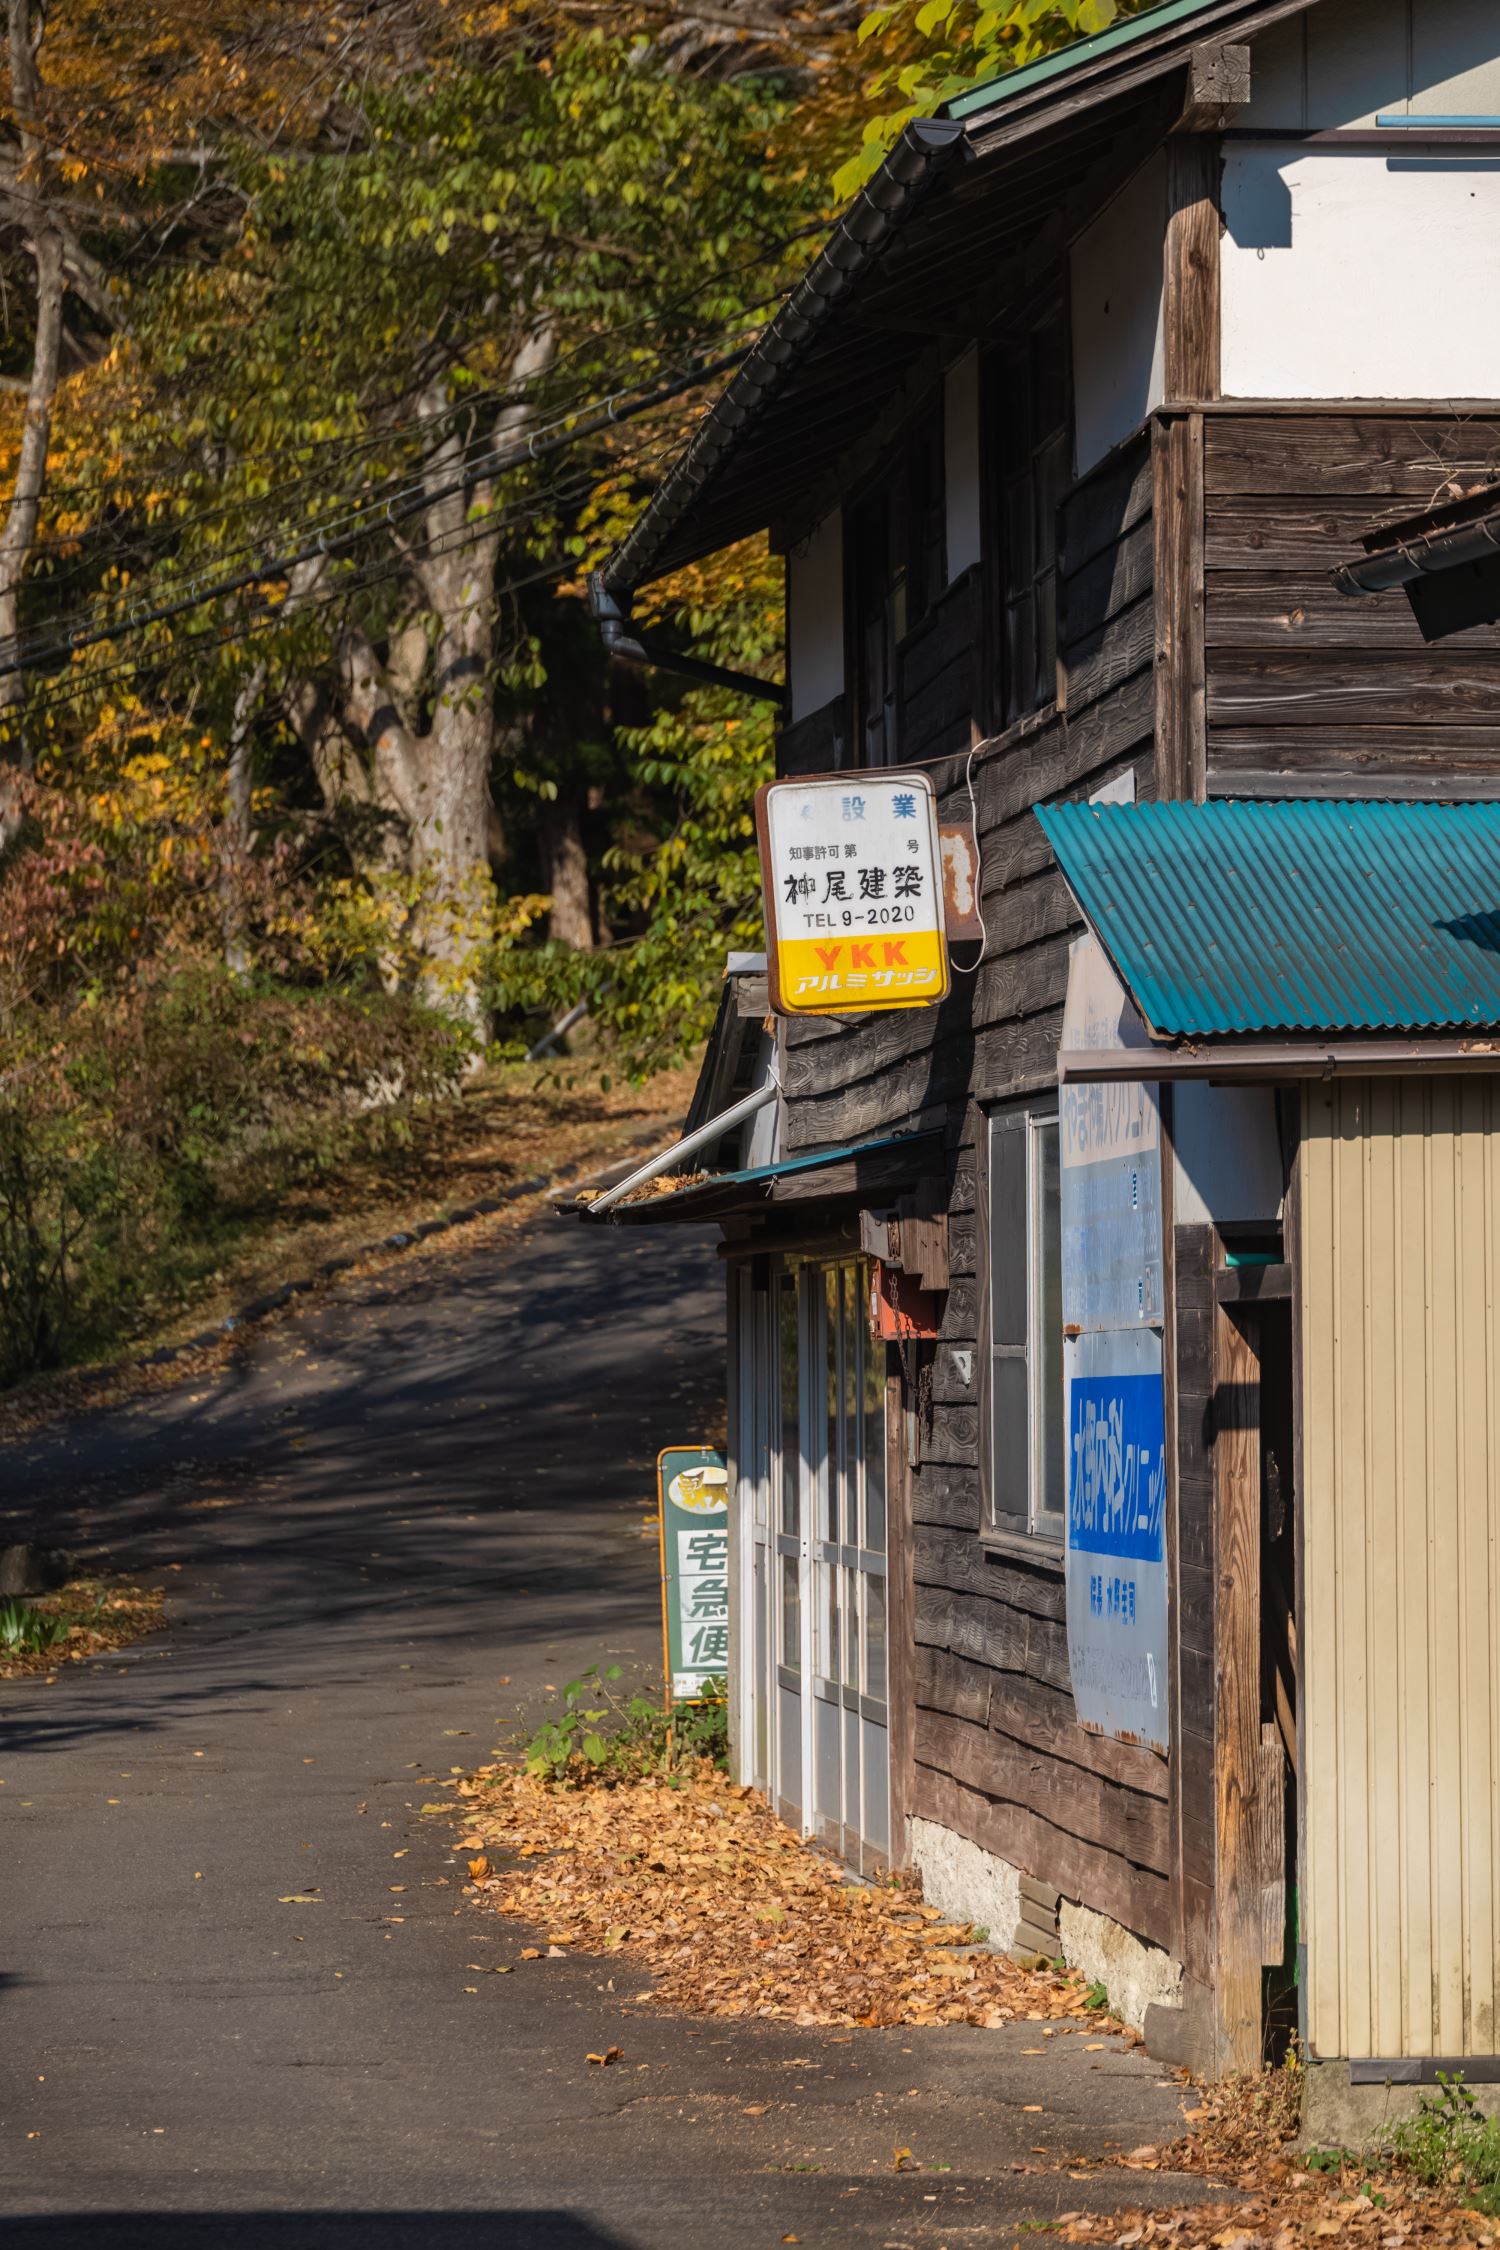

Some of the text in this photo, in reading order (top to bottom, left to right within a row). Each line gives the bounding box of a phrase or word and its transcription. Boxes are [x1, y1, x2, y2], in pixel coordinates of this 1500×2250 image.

[906, 839, 920, 854] 号
[784, 864, 924, 906] 神尾建築
[803, 905, 915, 928] TEL 9-2020
[814, 940, 909, 972] YKK
[794, 967, 937, 995] アルミサッシ
[685, 1533, 729, 1665] 宅急便
